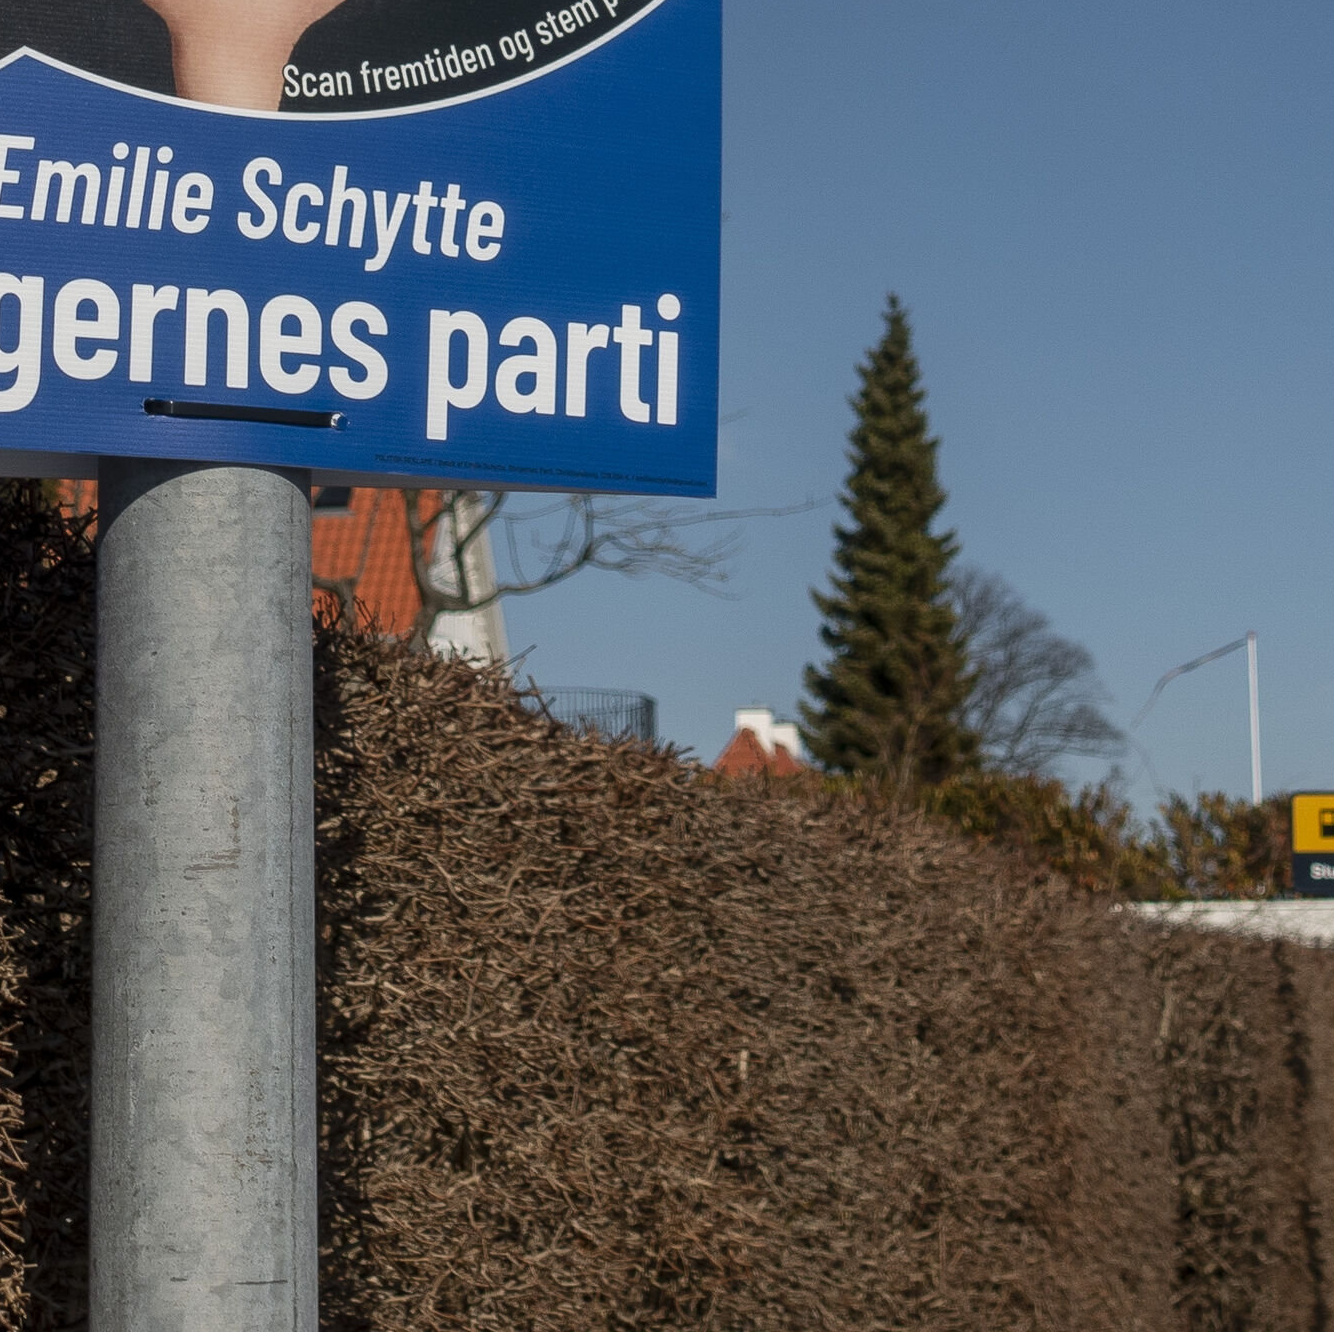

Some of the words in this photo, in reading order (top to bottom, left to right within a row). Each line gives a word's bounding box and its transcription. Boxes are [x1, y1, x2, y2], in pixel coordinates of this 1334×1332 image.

[282, 64, 354, 98] Scan
[360, 42, 496, 94] fremtiden
[498, 28, 536, 62] og
[237, 156, 506, 272] Schytte
[425, 293, 681, 441] parti
